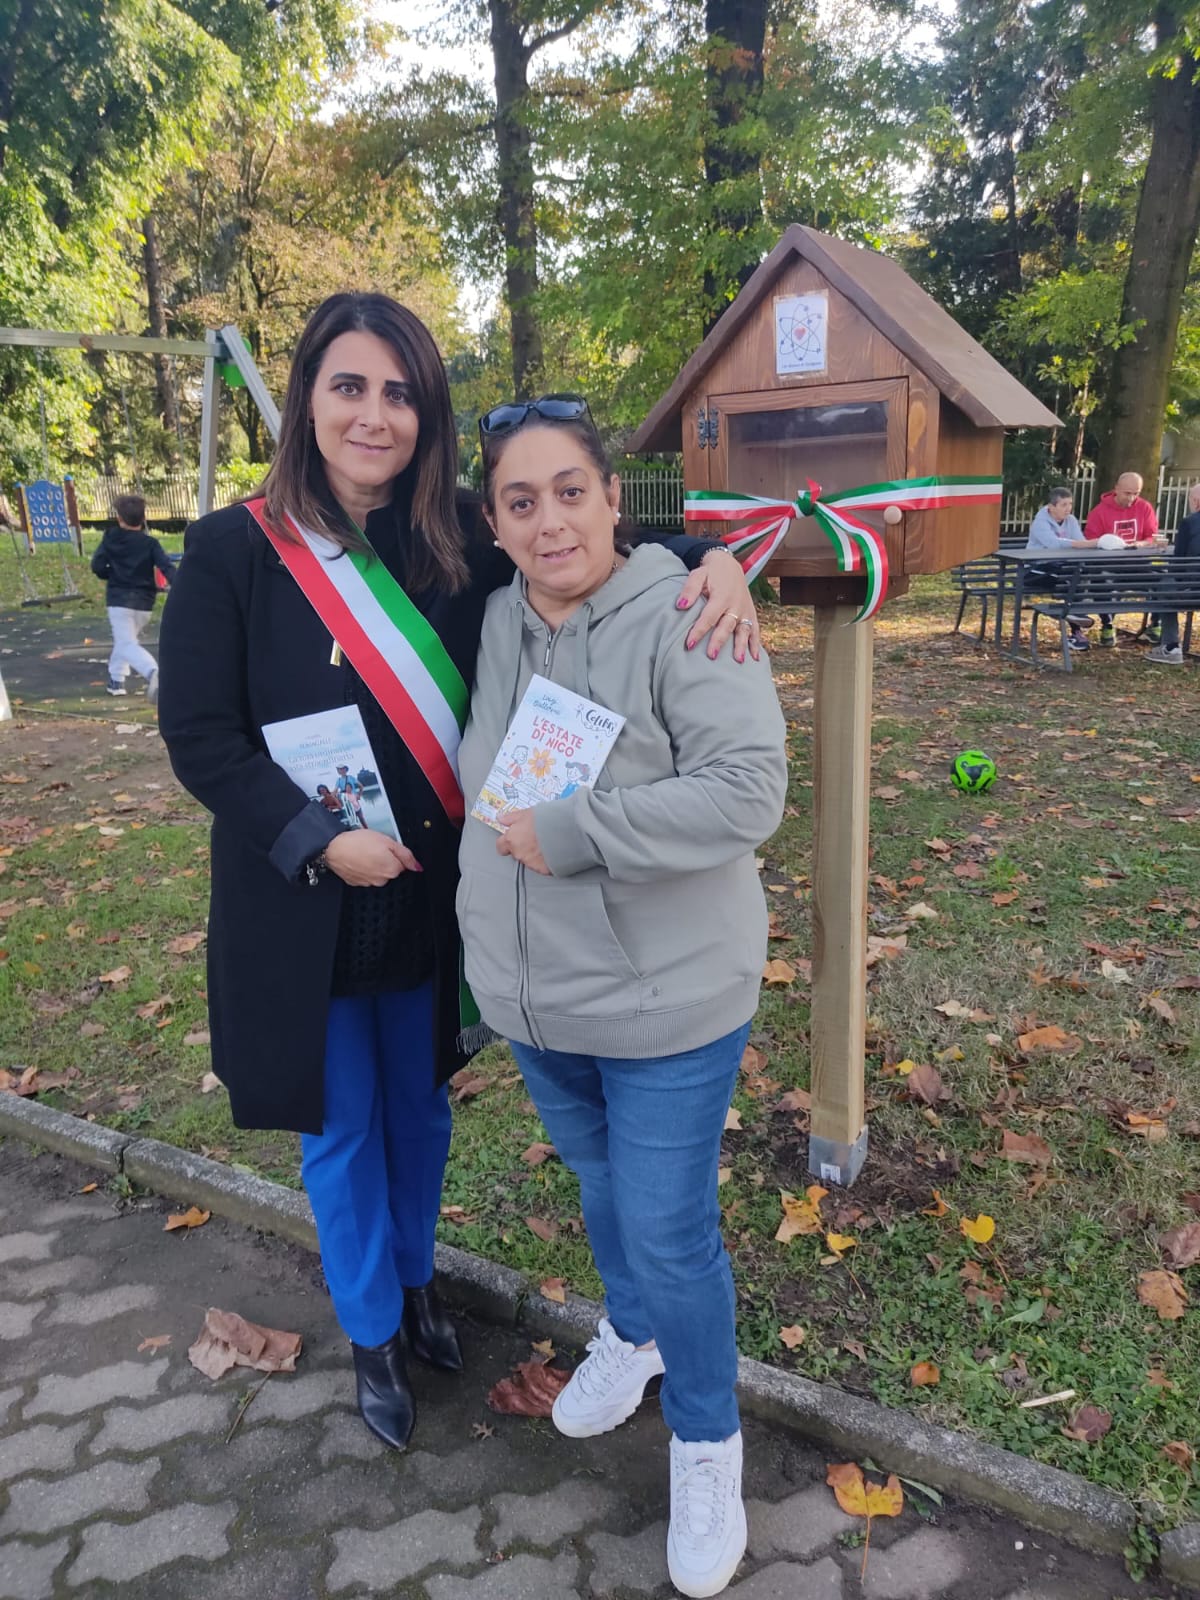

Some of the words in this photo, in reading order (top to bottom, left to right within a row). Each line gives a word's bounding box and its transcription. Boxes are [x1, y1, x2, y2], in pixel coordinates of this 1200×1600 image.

[531, 728, 545, 742] DI
[545, 737, 575, 757] NICO
[533, 715, 584, 749] L'ESTATE
